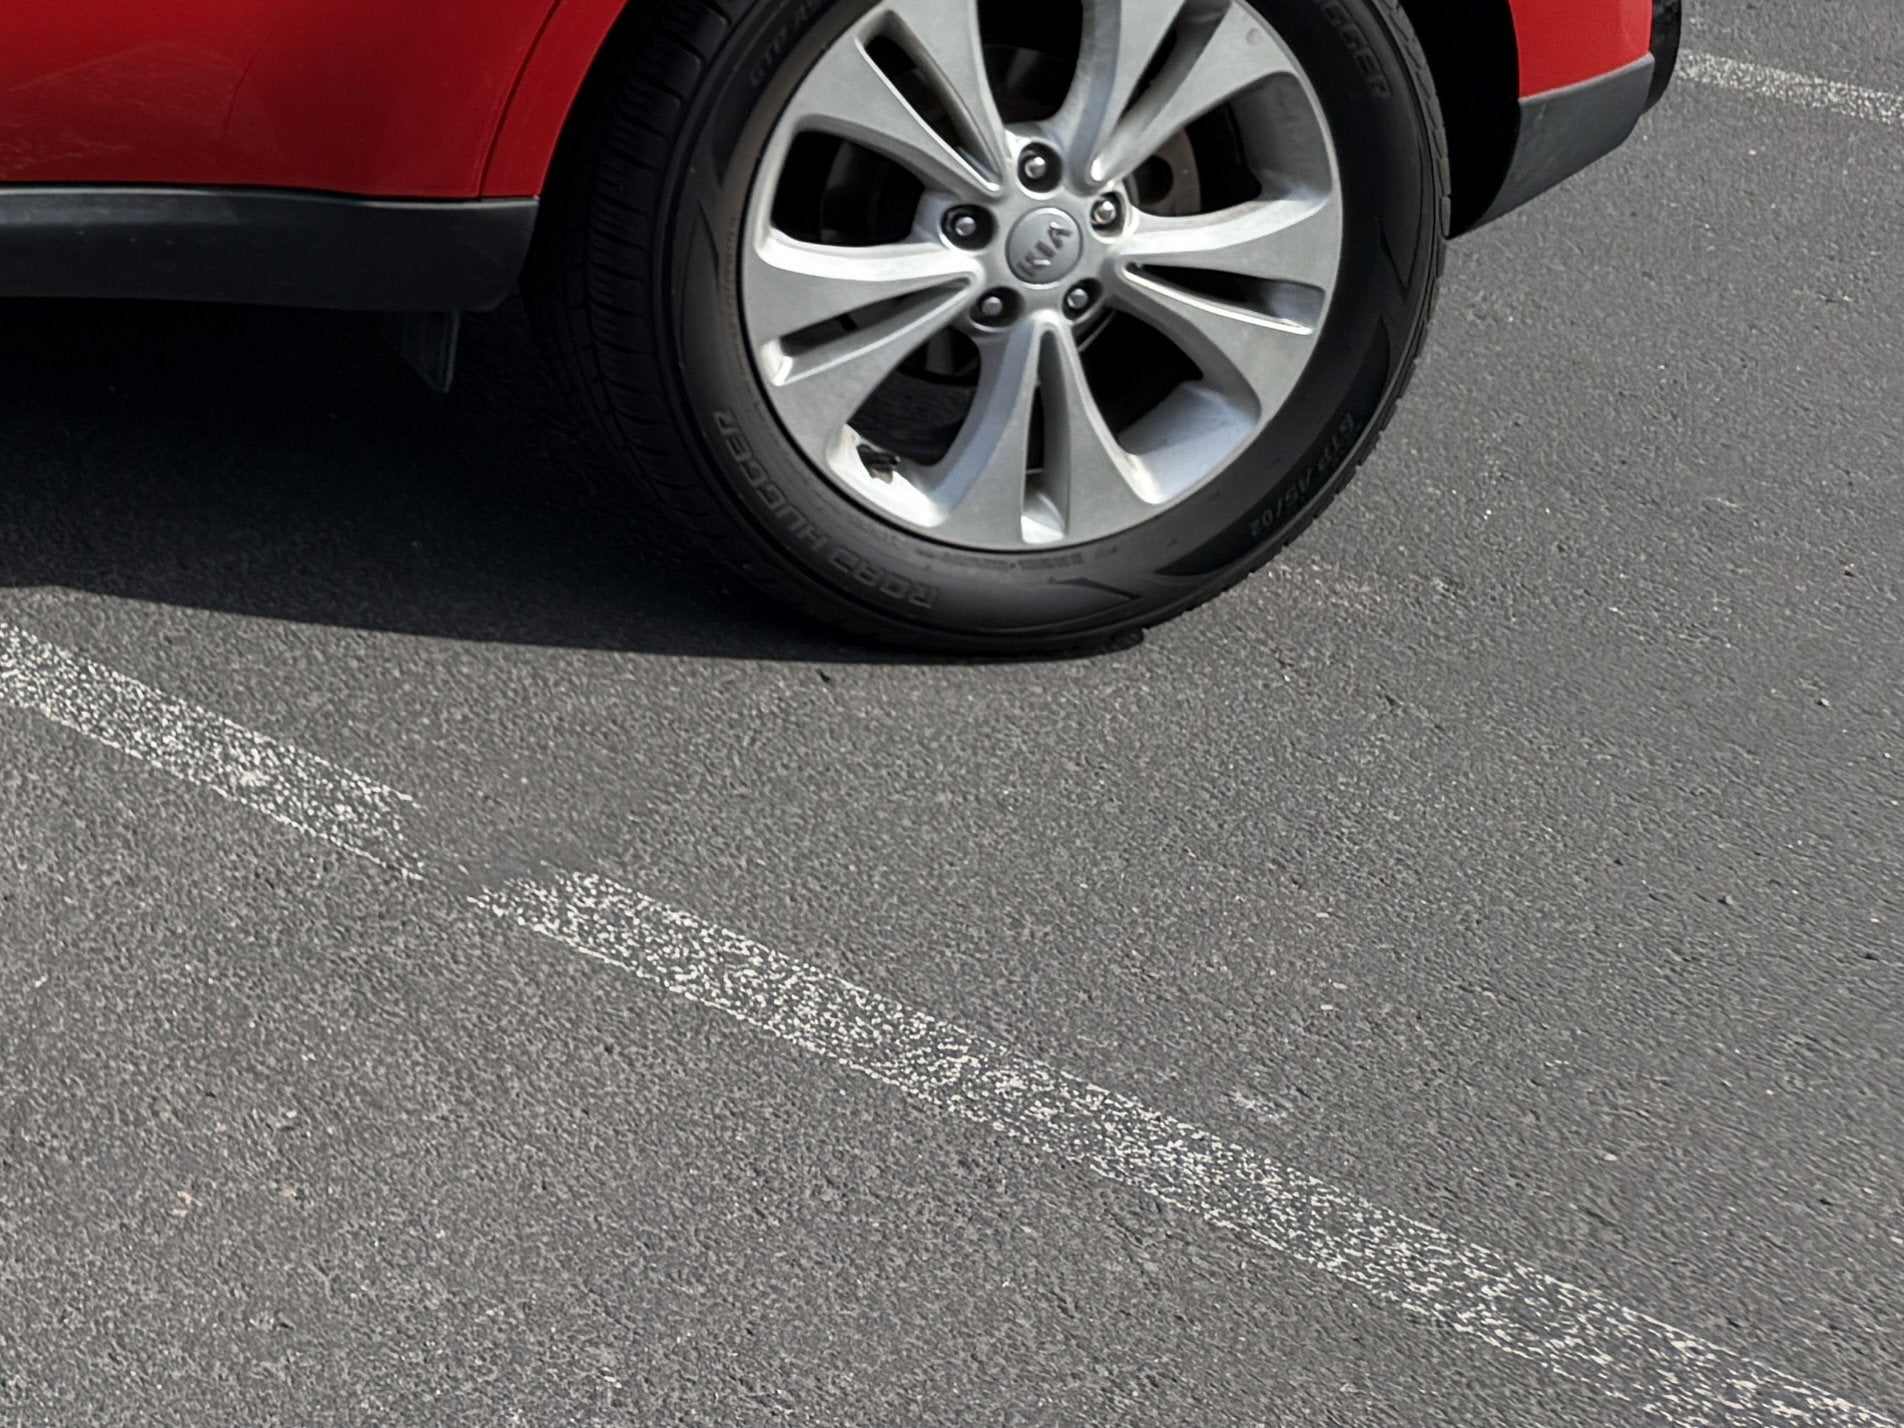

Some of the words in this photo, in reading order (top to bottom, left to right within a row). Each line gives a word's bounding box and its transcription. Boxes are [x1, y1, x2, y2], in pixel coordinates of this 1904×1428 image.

[1016, 221, 1074, 279] KIA
[711, 408, 831, 552] HUGGER
[827, 546, 939, 610] ROAD
